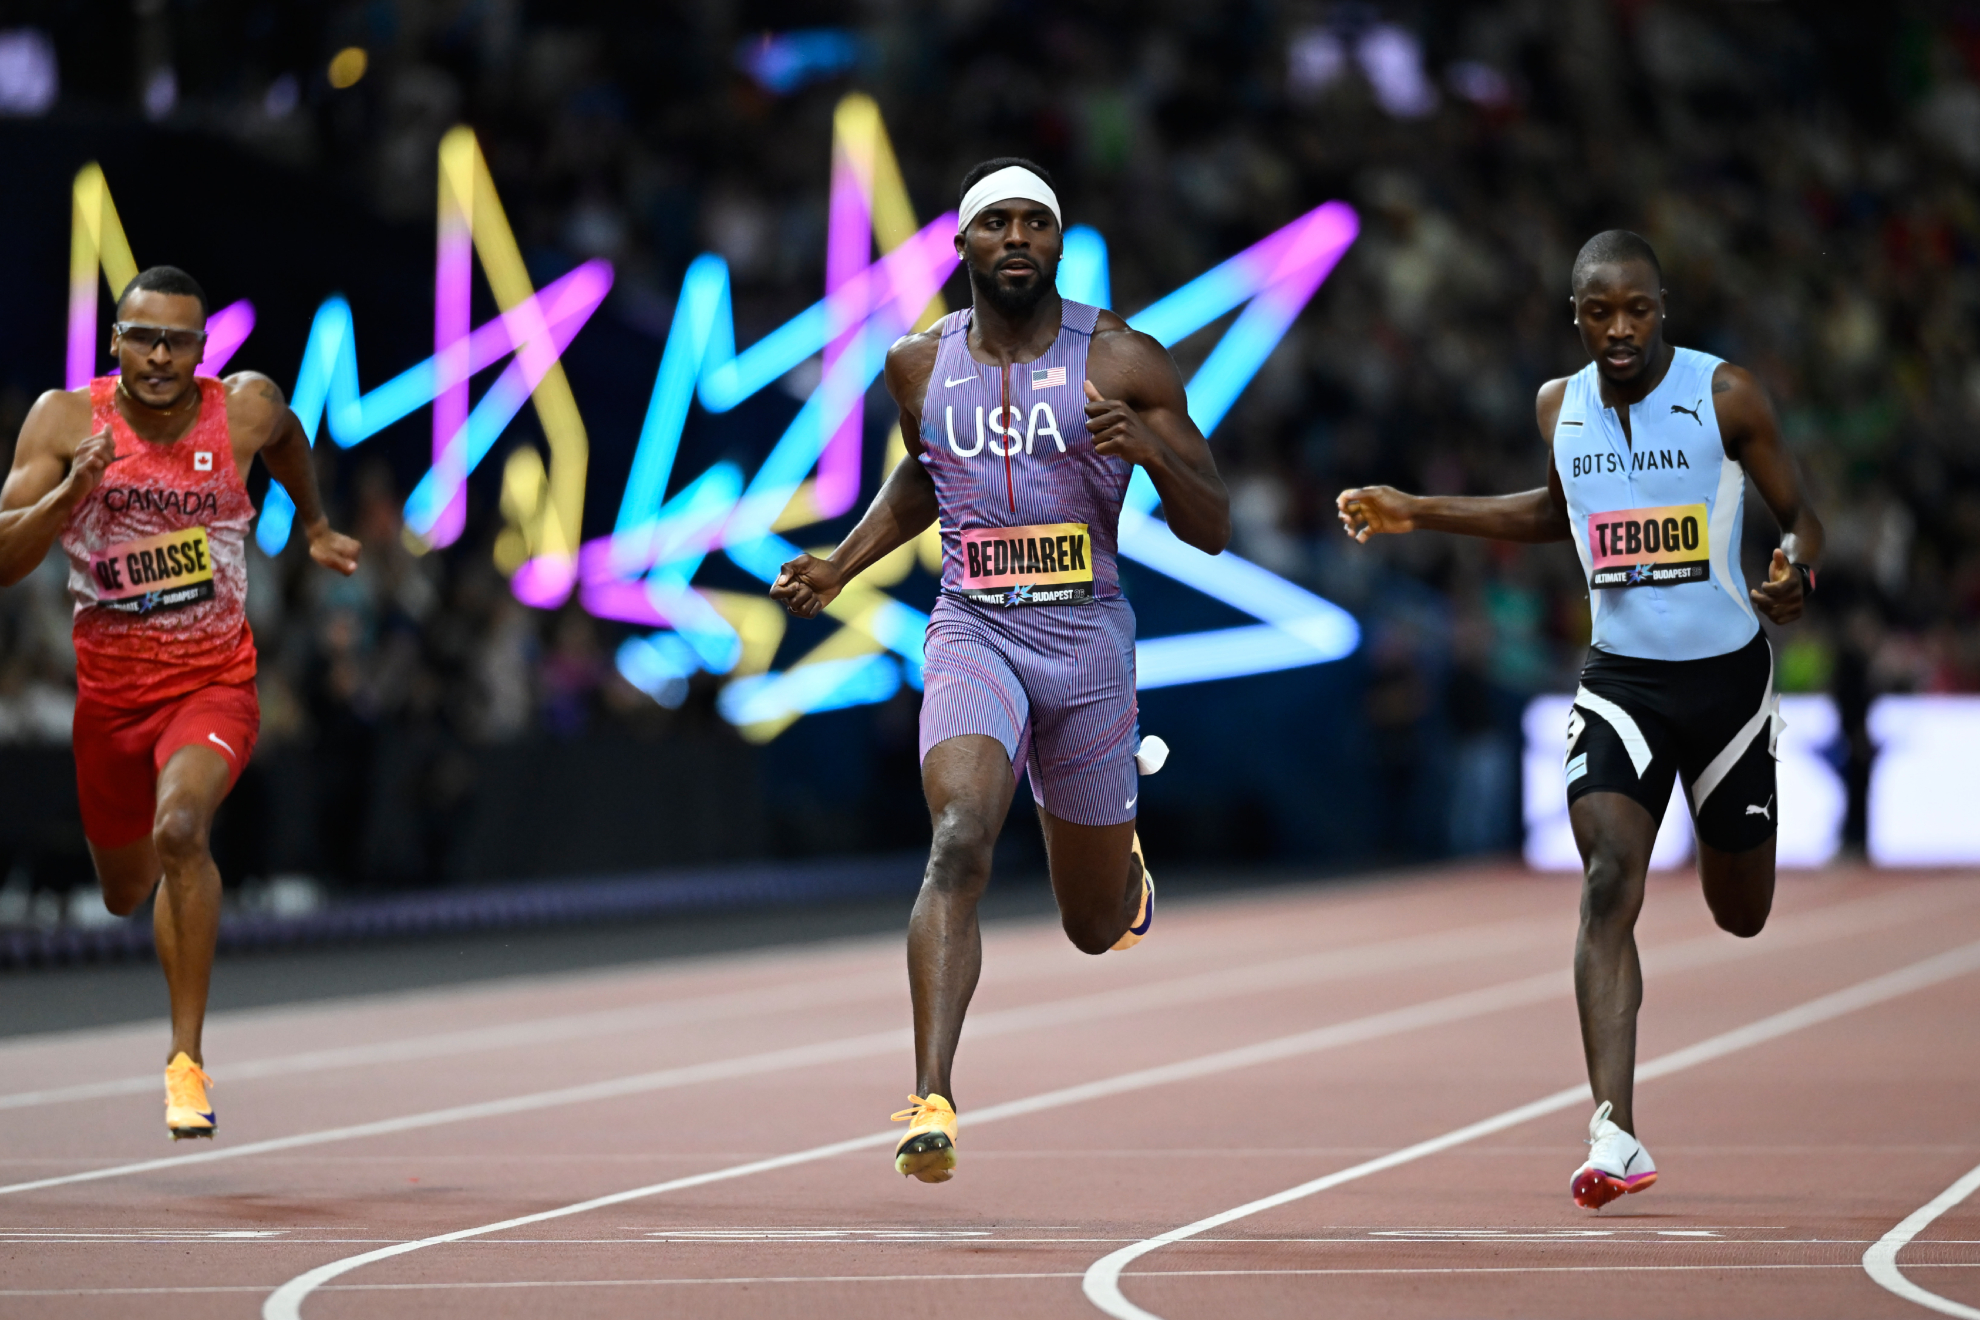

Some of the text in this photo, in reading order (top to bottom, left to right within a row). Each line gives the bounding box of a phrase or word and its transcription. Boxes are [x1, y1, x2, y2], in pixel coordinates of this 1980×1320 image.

[946, 401, 1066, 458] USA
[1573, 449, 1690, 478] BOTSWANA
[105, 488, 218, 516] CANADA
[1596, 515, 1699, 558] TEBOGO
[96, 539, 207, 591] DE GRASSE
[966, 534, 1086, 579] BEDNAREK
[1652, 567, 1692, 580] BUDAPEST
[1032, 589, 1073, 603] BUDAPEST
